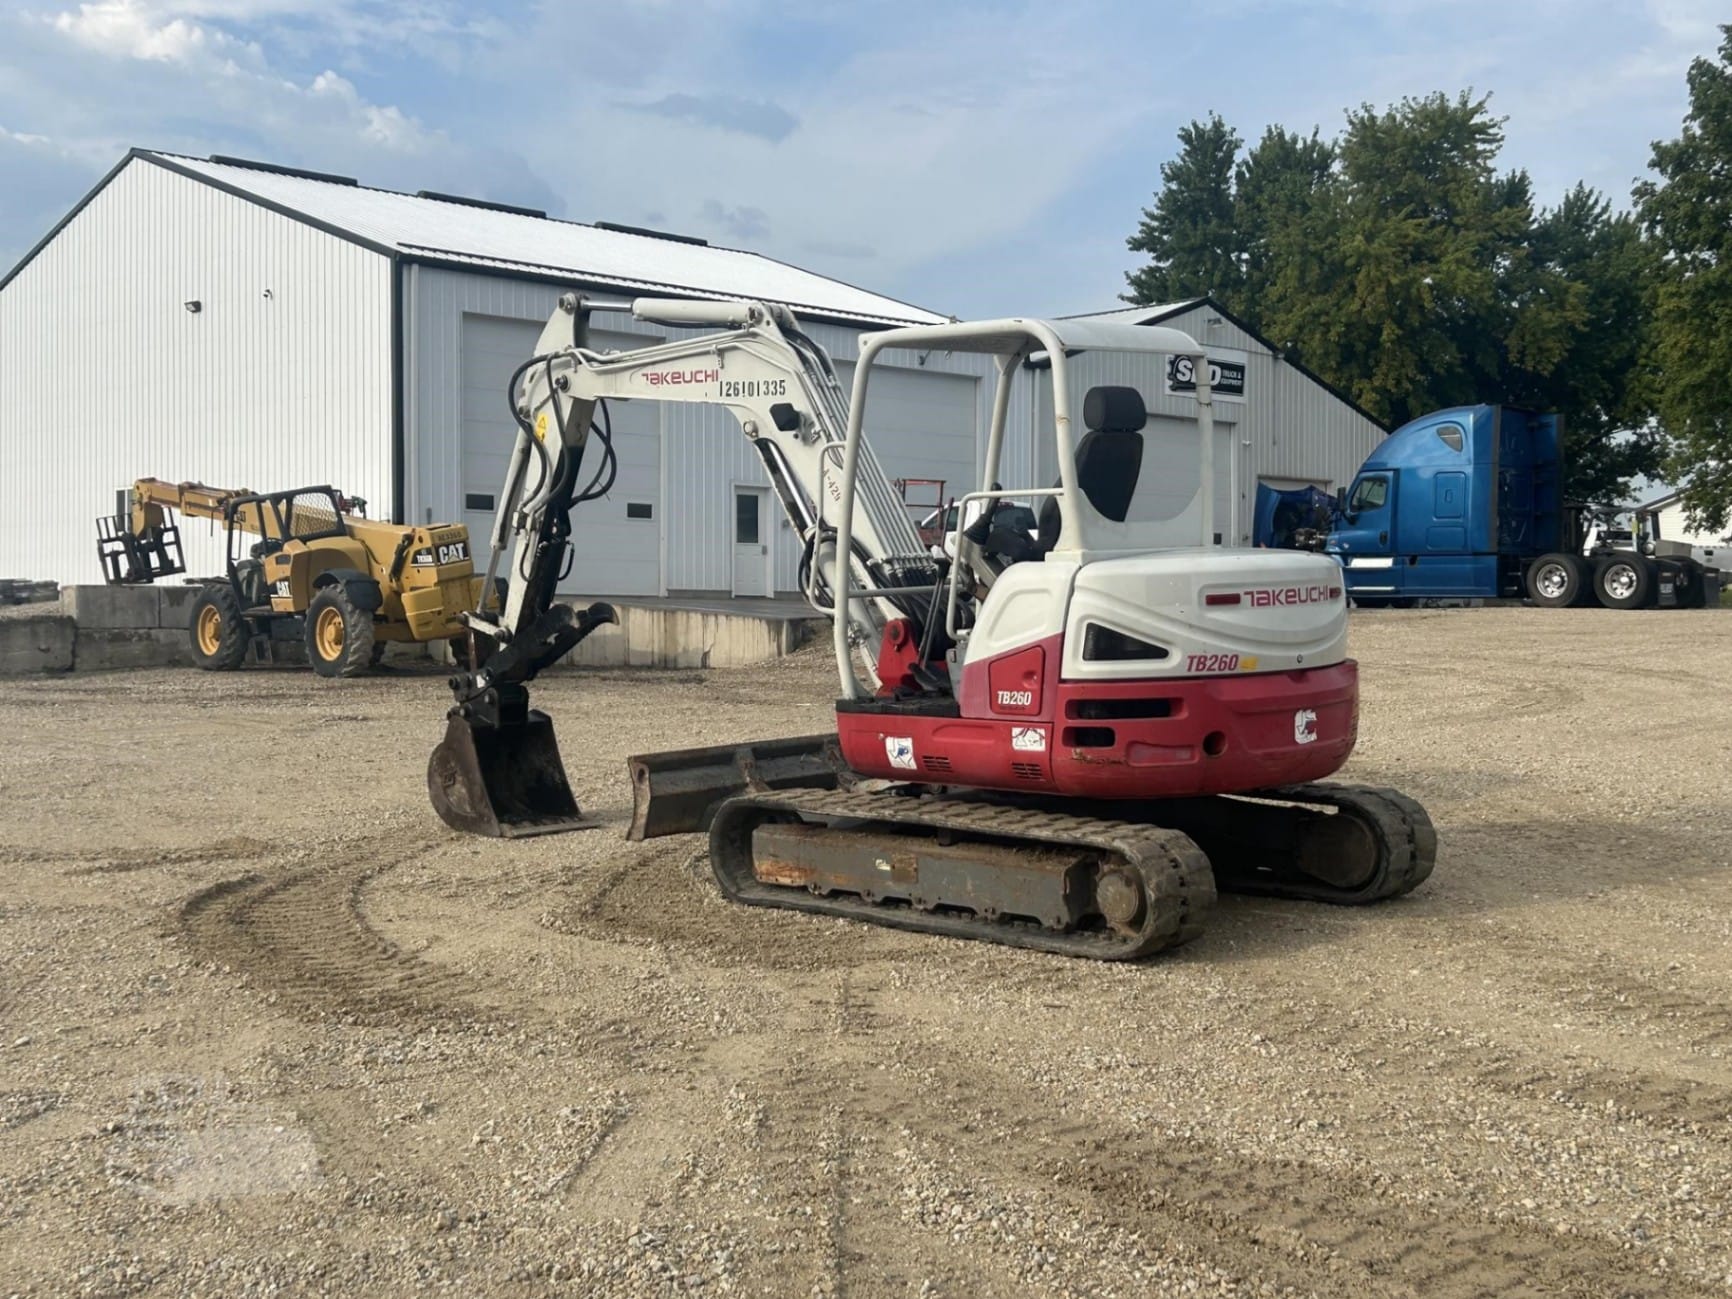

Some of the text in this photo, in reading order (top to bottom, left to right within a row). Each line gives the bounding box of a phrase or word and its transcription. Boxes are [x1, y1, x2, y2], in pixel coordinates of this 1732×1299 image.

[1176, 360, 1221, 385] SD
[439, 543, 464, 564] CAT
[1187, 654, 1239, 672] TB260
[997, 690, 1032, 705] TB260
